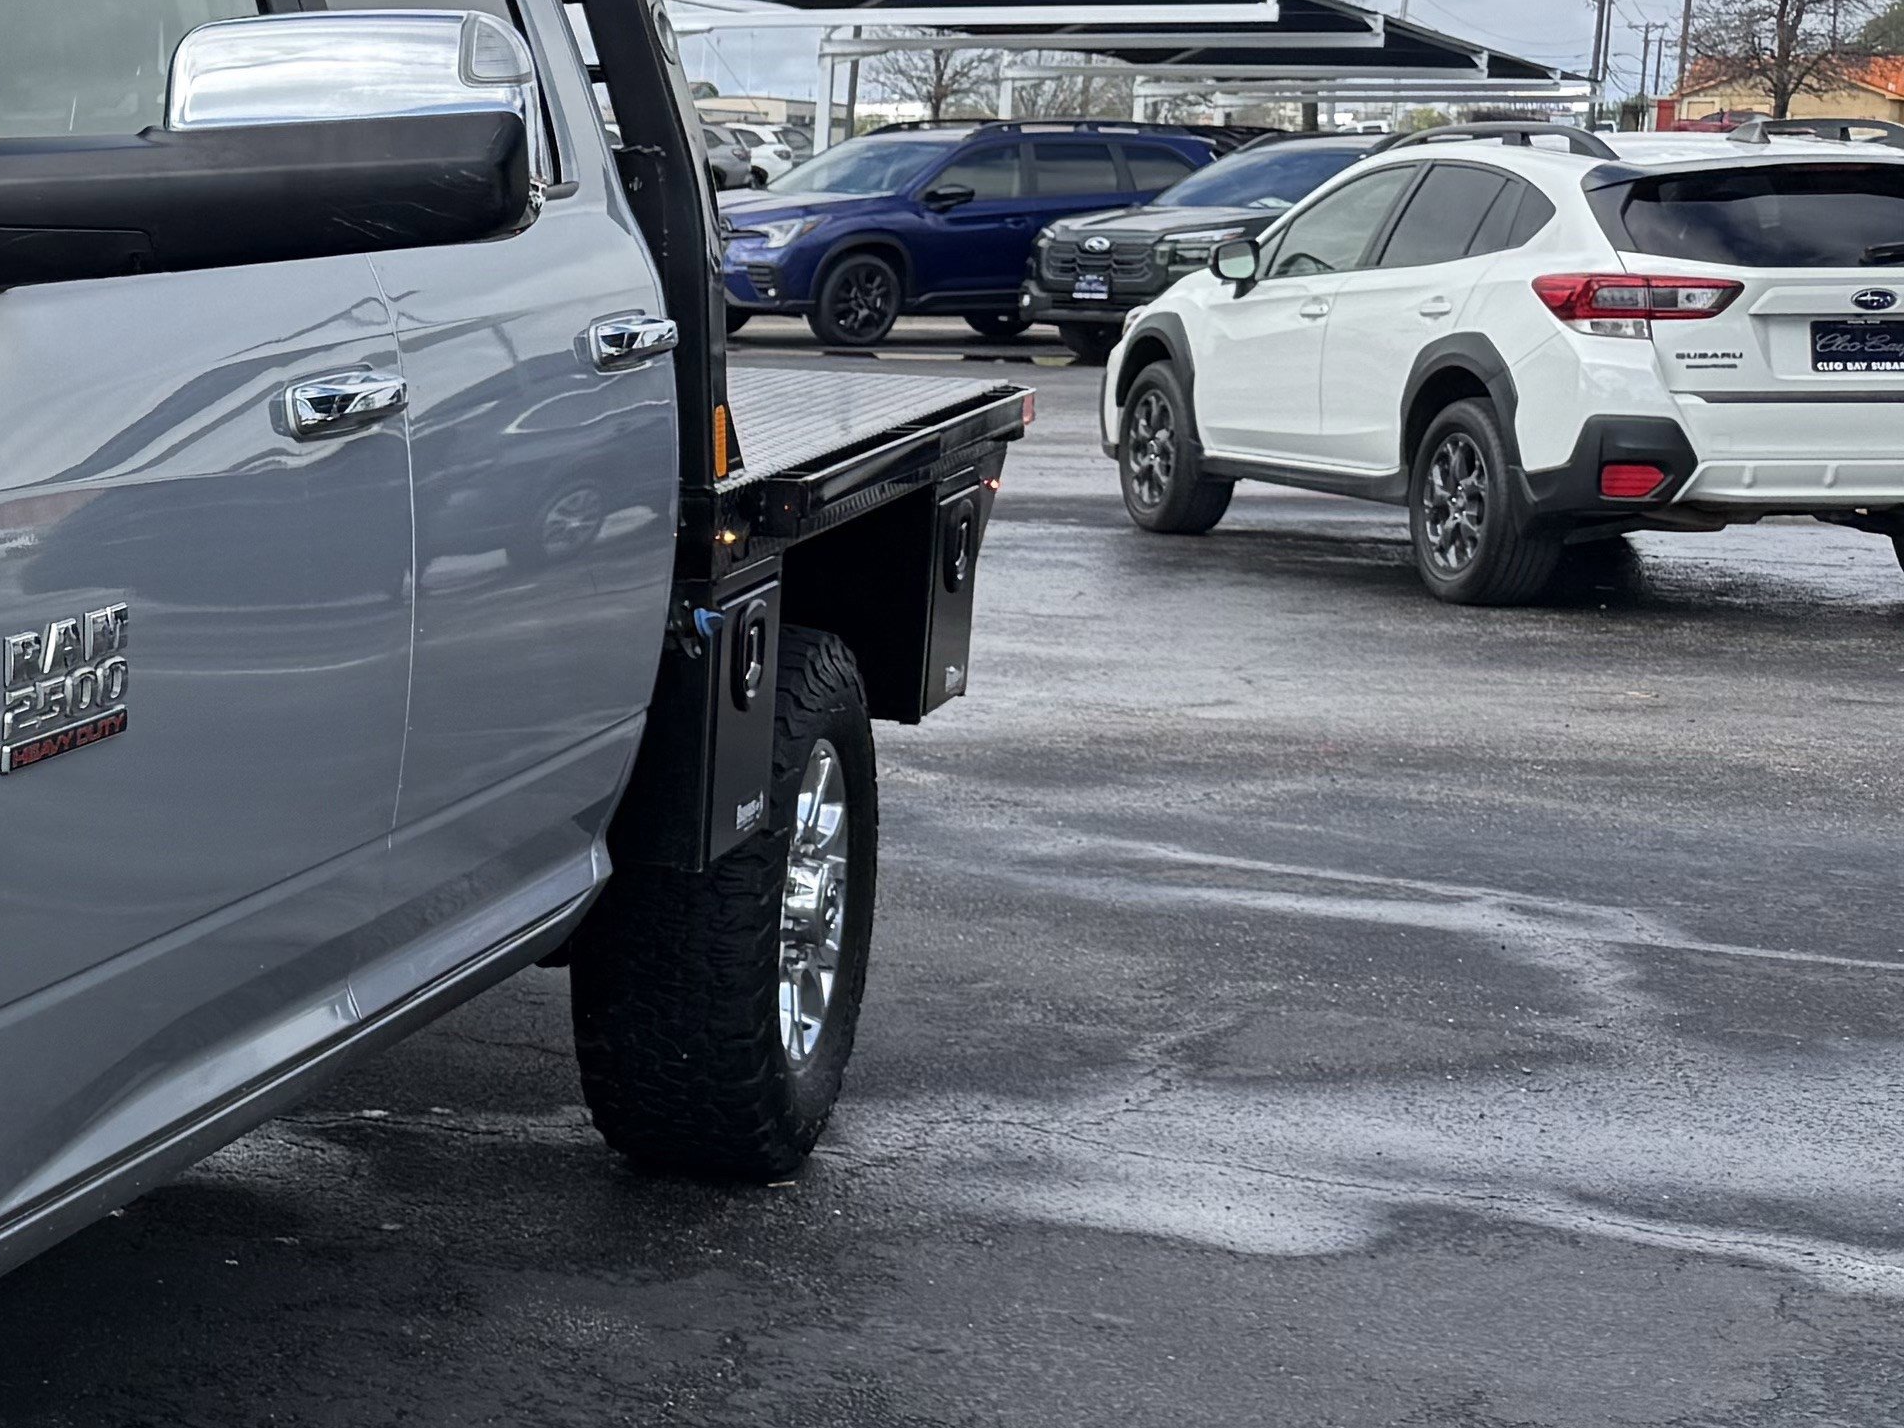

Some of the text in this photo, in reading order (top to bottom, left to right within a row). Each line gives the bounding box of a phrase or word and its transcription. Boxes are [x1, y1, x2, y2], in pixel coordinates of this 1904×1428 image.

[1675, 352, 1743, 360] SUBARU
[1816, 361, 1844, 371] CLEO
[1846, 361, 1868, 371] BAY
[4, 602, 129, 688] RAM
[3, 655, 129, 740] 2500
[12, 728, 74, 767] HEAVY
[77, 713, 124, 747] DUTY
